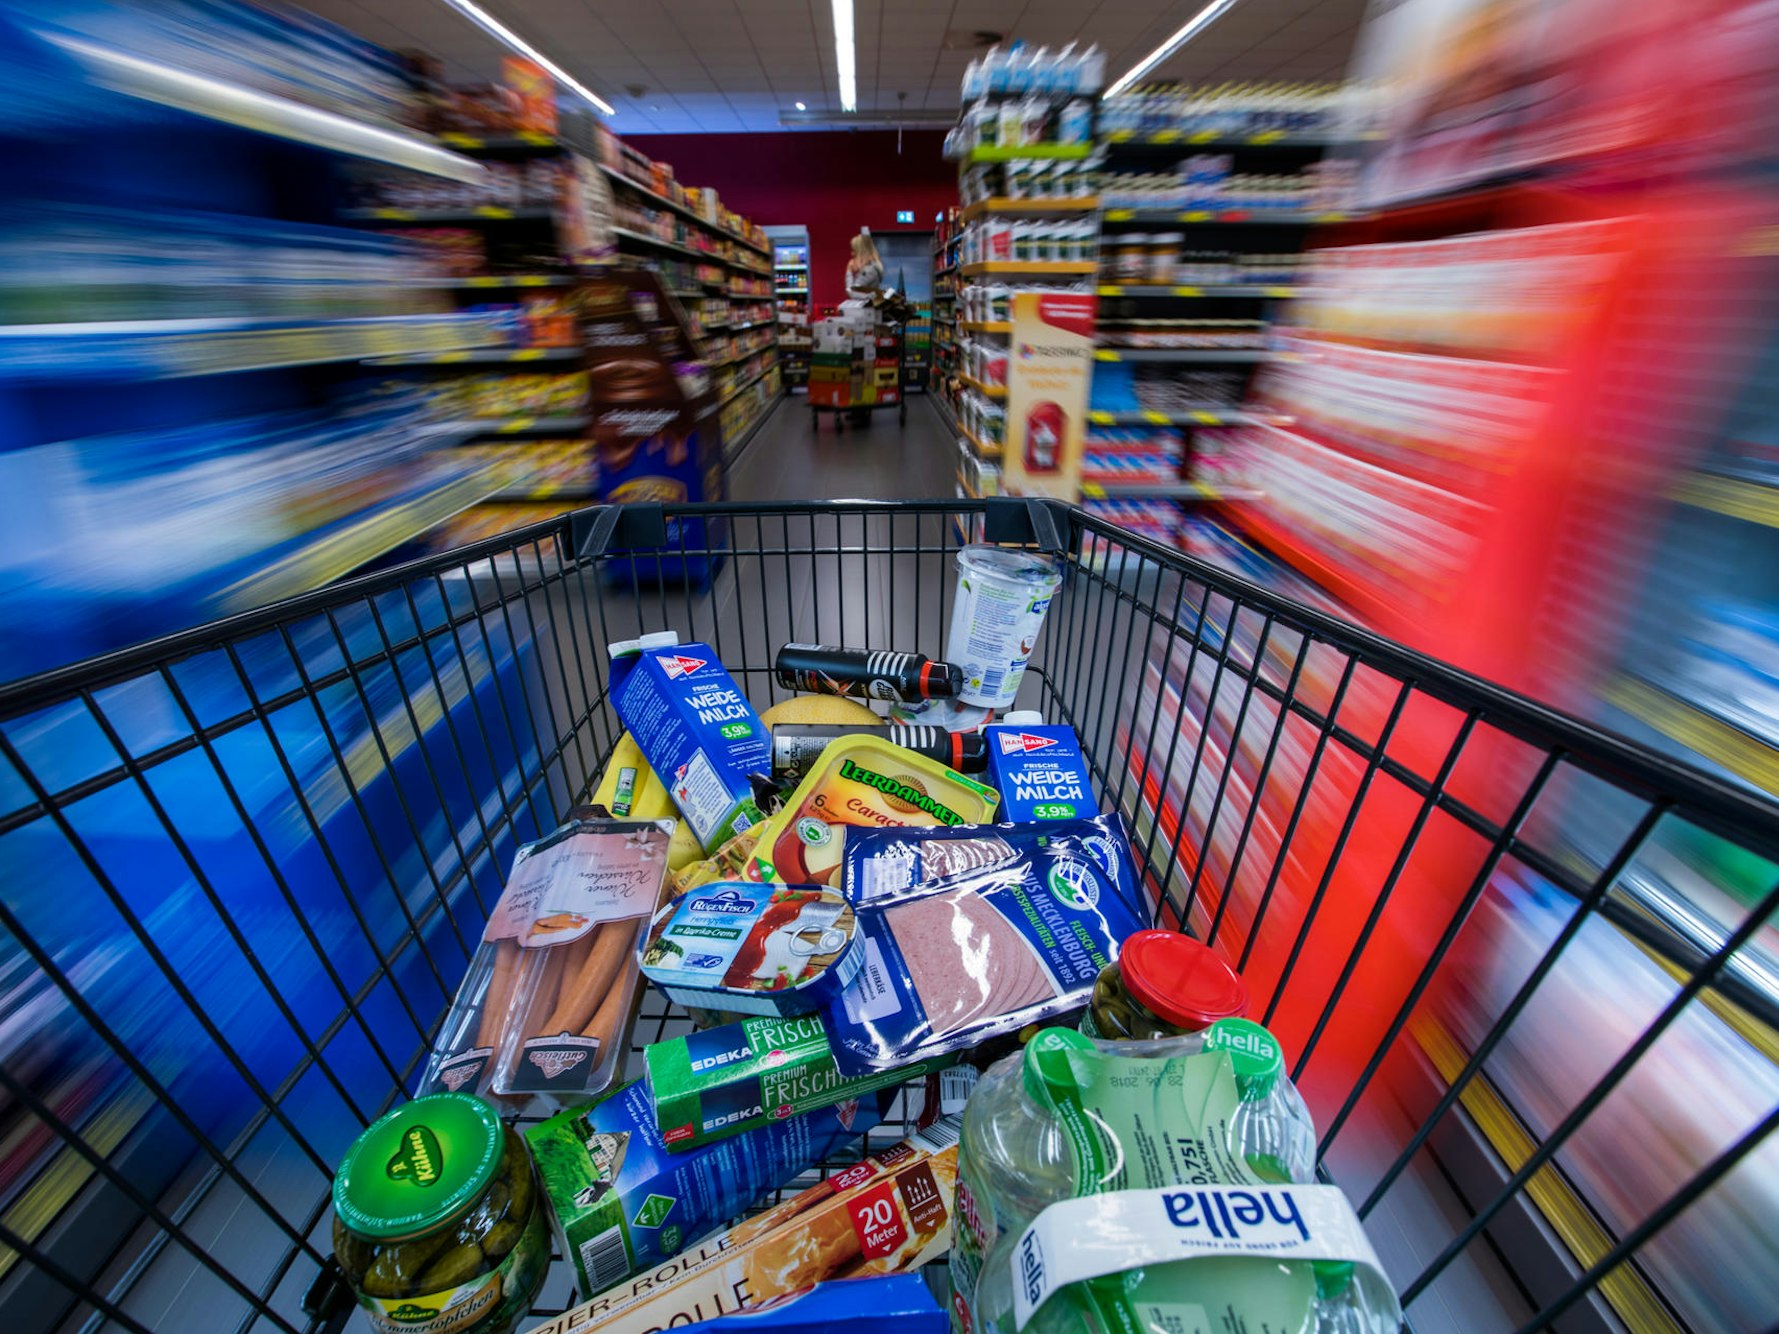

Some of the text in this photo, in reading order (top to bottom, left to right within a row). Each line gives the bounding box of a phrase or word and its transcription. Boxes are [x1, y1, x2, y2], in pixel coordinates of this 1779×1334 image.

[684, 690, 740, 710] WEIDE
[699, 704, 750, 725] MILCH
[1008, 771, 1080, 785] WEIDE
[815, 795, 828, 807] 6
[838, 759, 964, 826] LEERDAMMER
[1016, 786, 1083, 801] MILCH
[846, 798, 912, 826] Caract
[584, 882, 637, 898] Wiener
[1010, 882, 1076, 984] RSTSPEZIALITÄTEN seit 1892
[1034, 891, 1098, 979] MECKLENBURG
[1069, 920, 1095, 953] FLEISCH-
[868, 965, 885, 994] LEBERKÄSE
[750, 1016, 824, 1052] FRISCH
[1217, 1027, 1273, 1058] hella
[528, 1050, 587, 1062] Gutfleisch
[692, 1047, 753, 1071] EDEKA
[763, 1064, 806, 1086] PREMIUM
[703, 1105, 763, 1130] EDEKA
[409, 1130, 436, 1181] Kühne
[1195, 1139, 1219, 1183] FLASCHE
[836, 1166, 867, 1180] 20
[858, 1199, 893, 1233] 20
[913, 1203, 942, 1222] Anti-Haft
[1161, 1191, 1311, 1242] hella
[866, 1223, 898, 1248] Meter
[1021, 1229, 1042, 1306] hella
